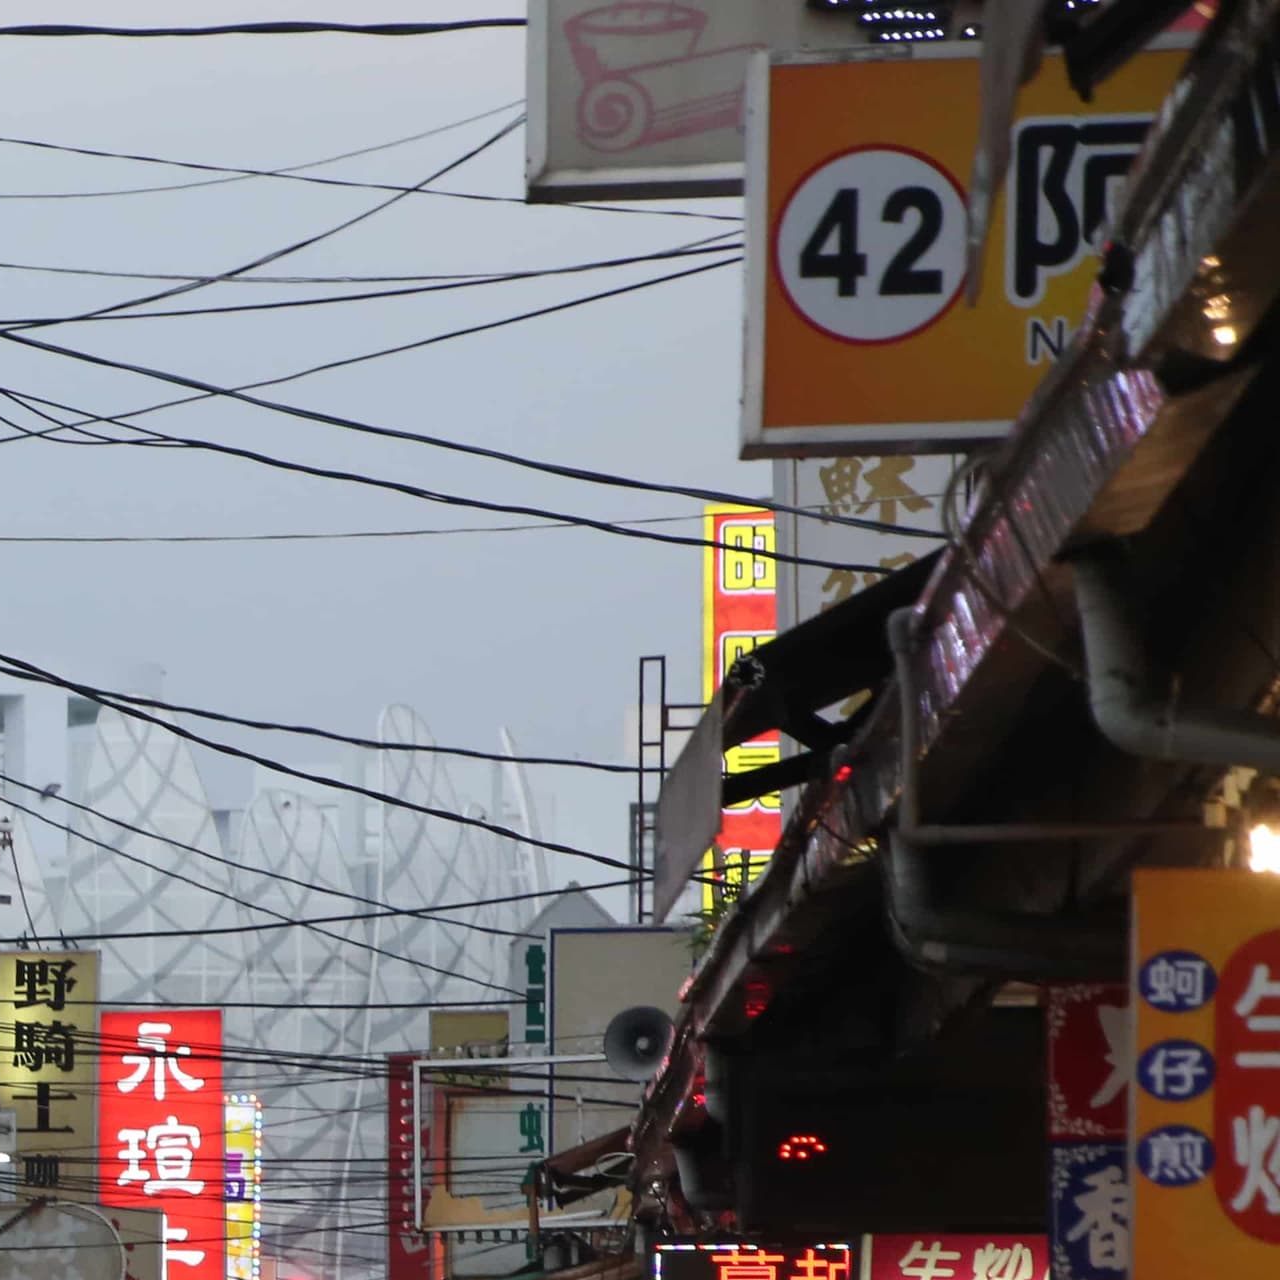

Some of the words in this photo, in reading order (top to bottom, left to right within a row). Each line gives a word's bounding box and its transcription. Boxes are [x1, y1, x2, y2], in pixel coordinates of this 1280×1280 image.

[799, 185, 946, 298] 42
[1147, 957, 1208, 1180] 蚵仔煎
